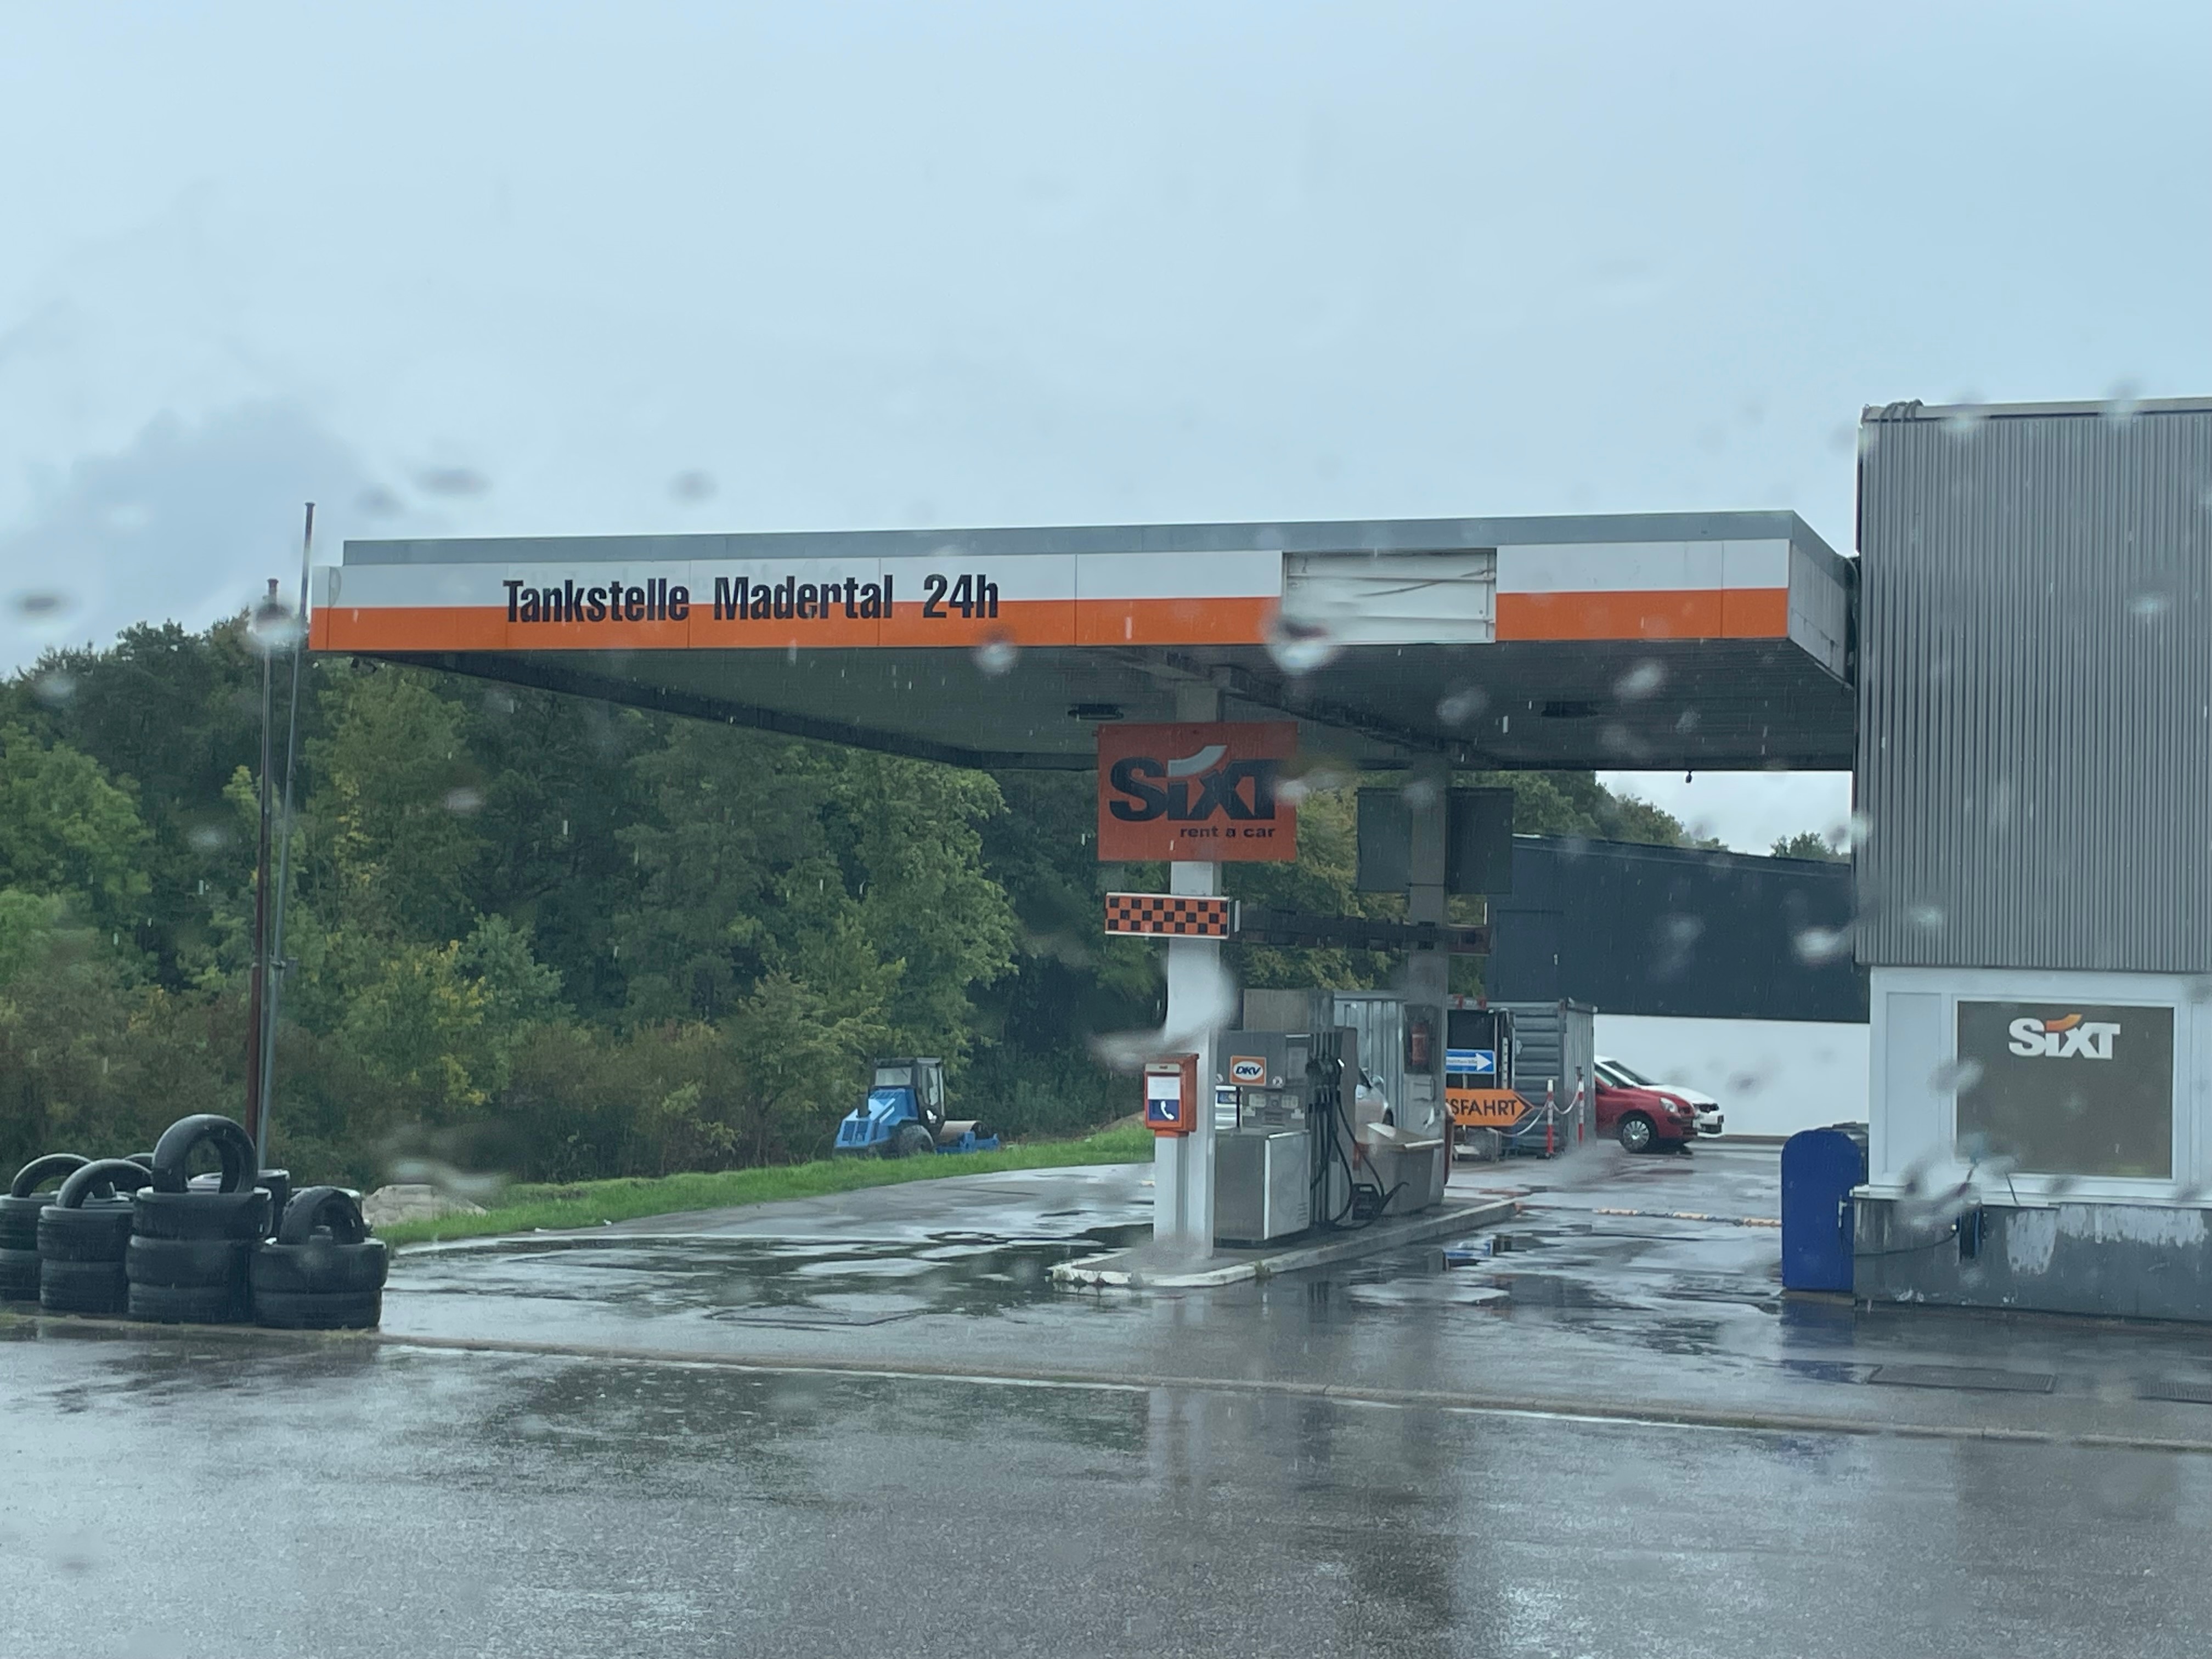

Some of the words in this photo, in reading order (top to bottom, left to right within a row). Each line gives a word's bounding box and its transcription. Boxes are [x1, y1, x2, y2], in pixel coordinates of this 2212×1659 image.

[503, 579, 689, 623] Tankstelle
[714, 575, 893, 621] Madertal
[924, 573, 998, 619] 24h
[1180, 826, 1218, 838] rent
[1225, 828, 1235, 838] a
[1243, 827, 1276, 838] car
[1235, 1066, 1261, 1076] DKV
[1445, 1098, 1517, 1116] SFAHRT
